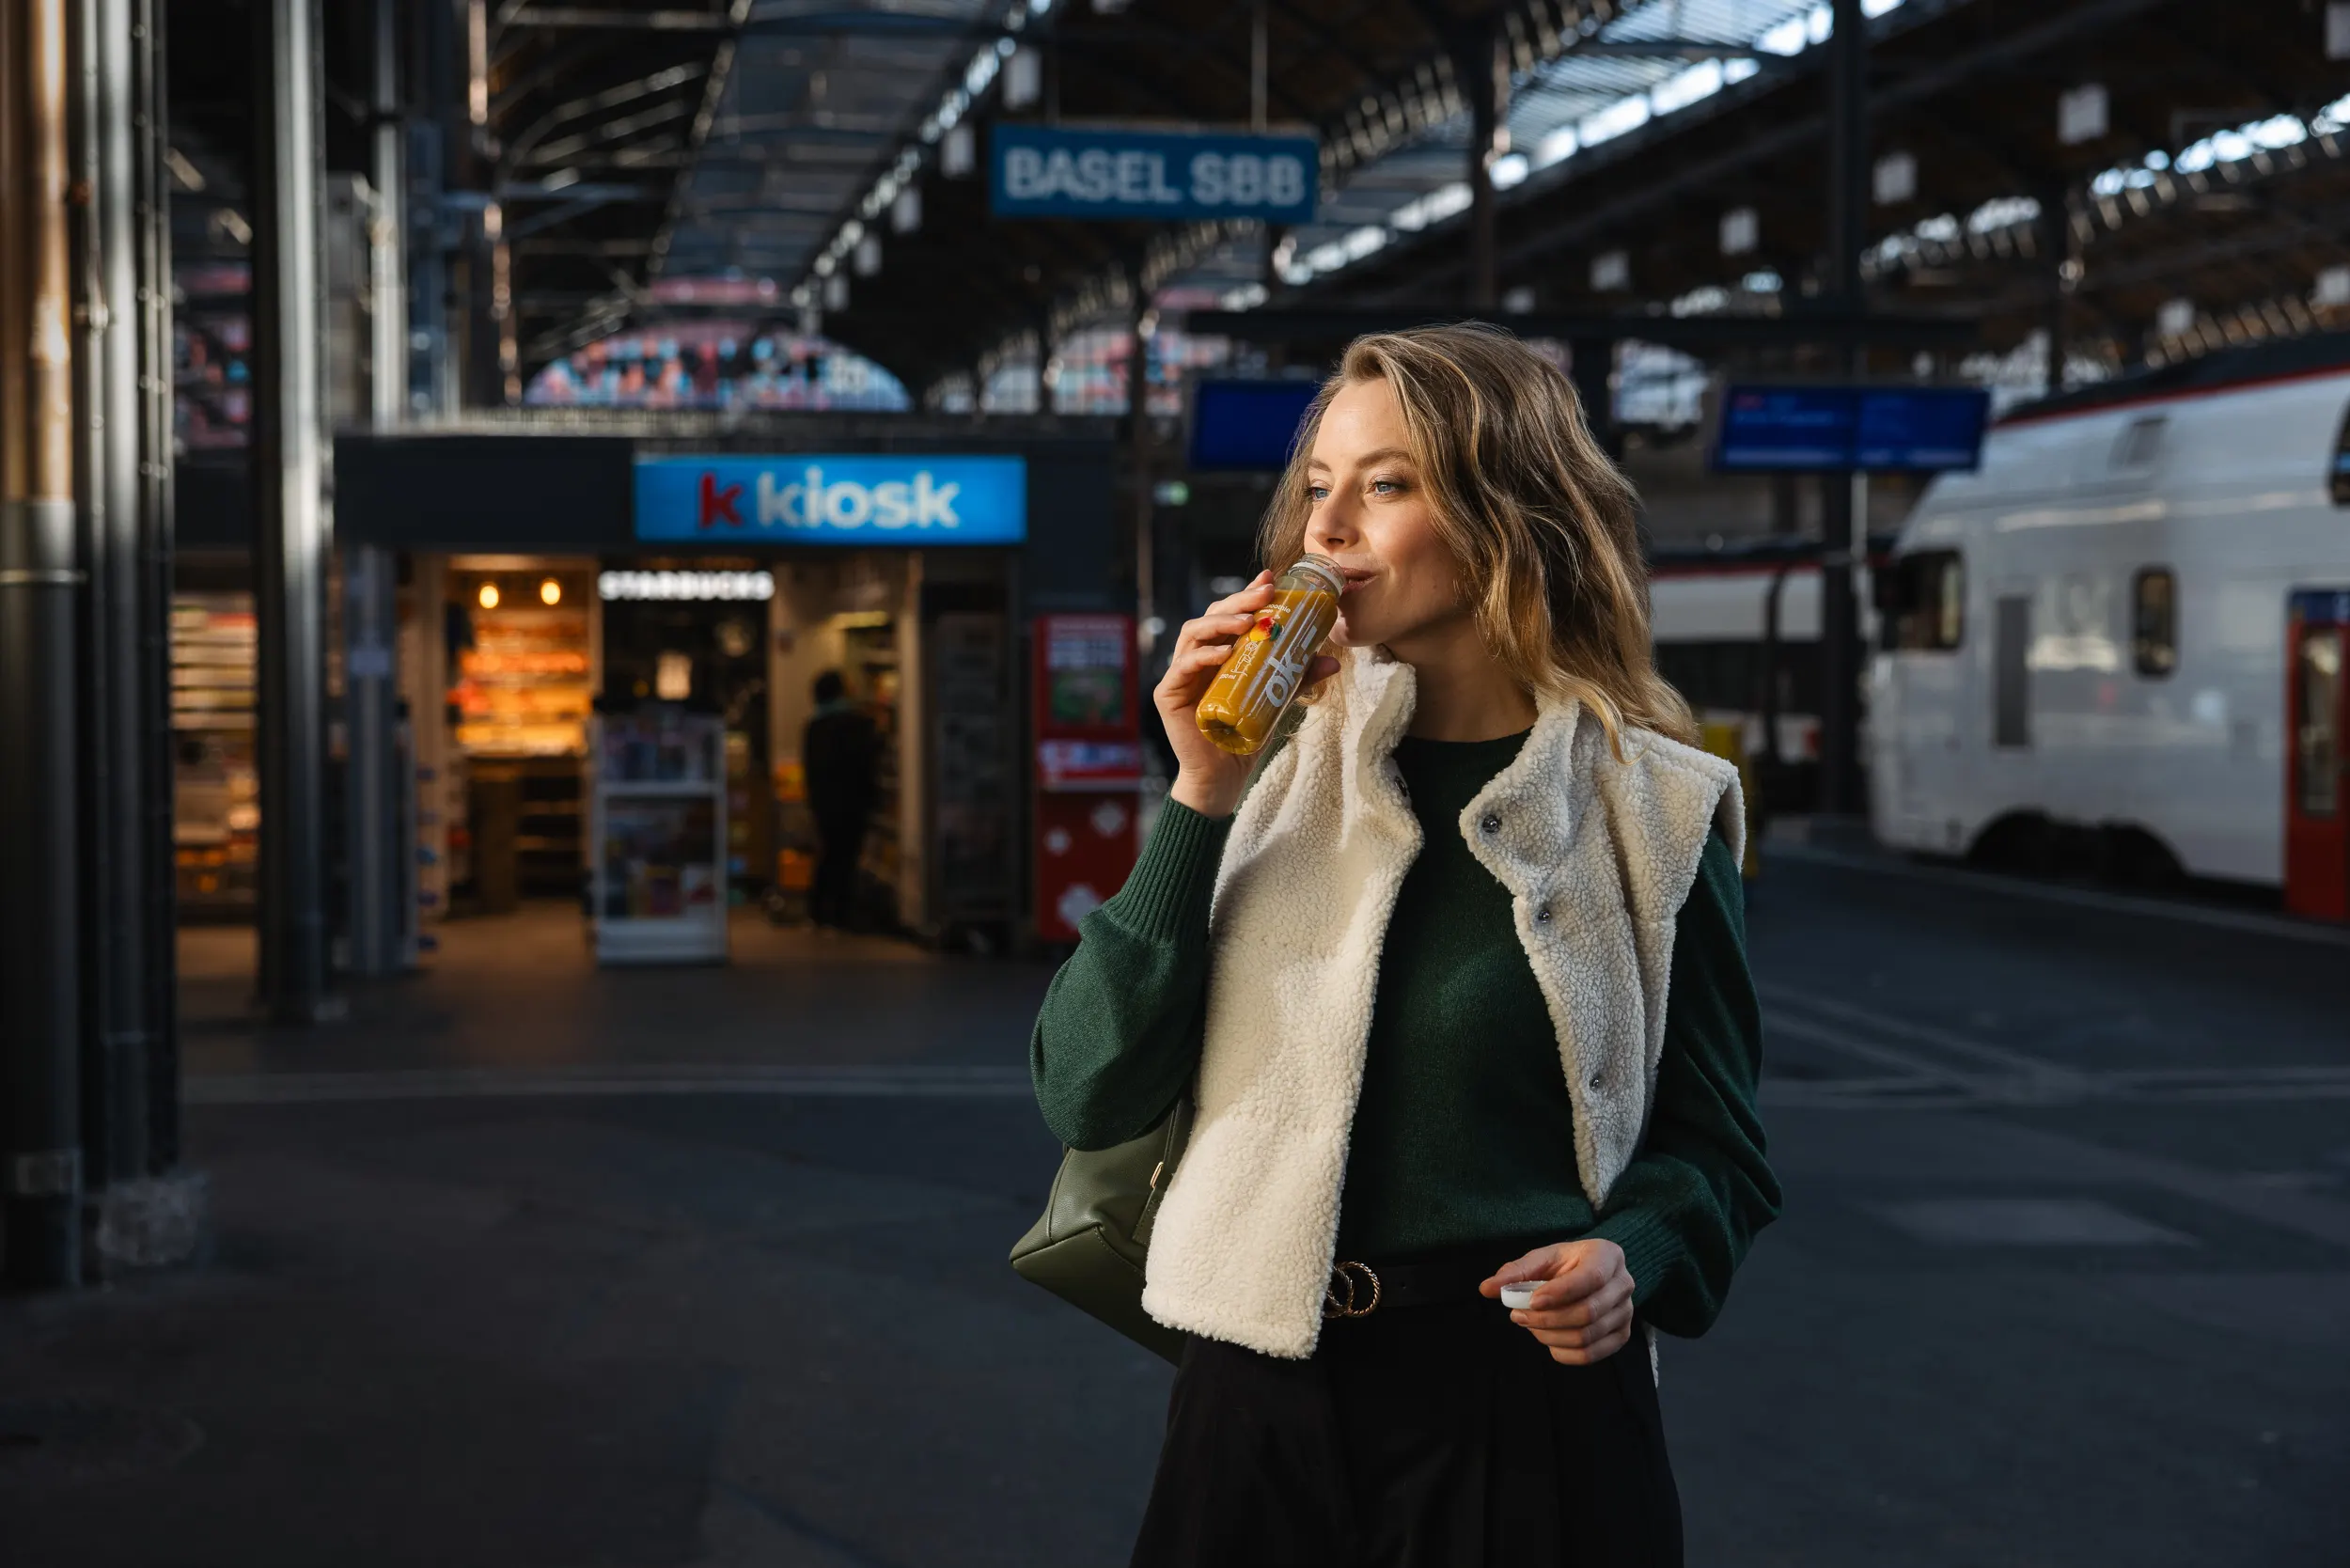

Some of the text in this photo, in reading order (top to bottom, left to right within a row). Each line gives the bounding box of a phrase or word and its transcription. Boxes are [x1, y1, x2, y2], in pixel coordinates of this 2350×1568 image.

[1005, 147, 1306, 207] BASEL SBB
[699, 465, 960, 529] k kiosk
[598, 570, 776, 601] STARBUCKS
